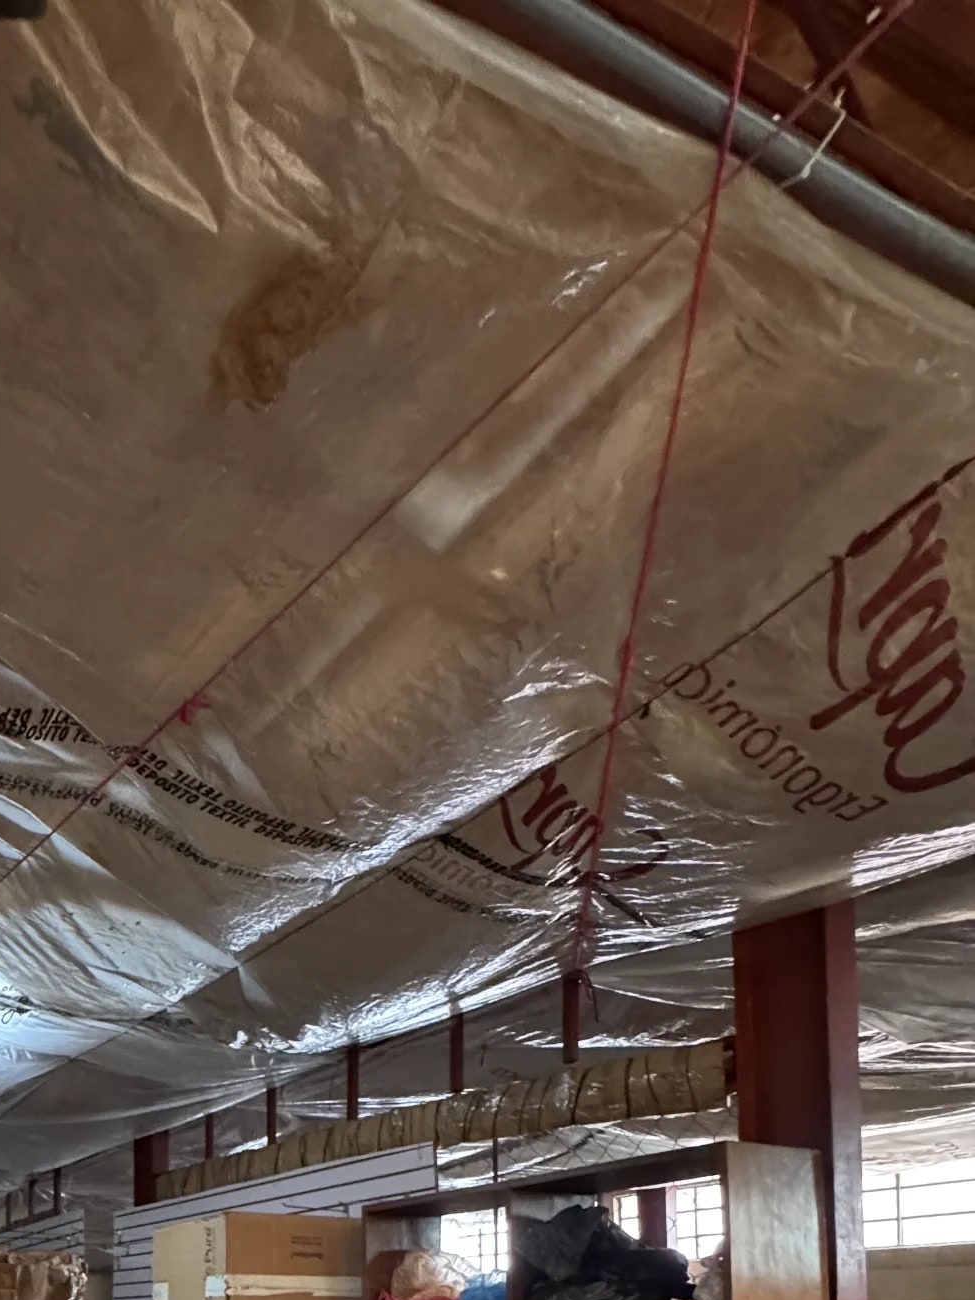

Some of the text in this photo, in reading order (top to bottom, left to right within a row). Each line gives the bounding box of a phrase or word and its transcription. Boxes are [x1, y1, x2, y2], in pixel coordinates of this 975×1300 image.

[125, 755, 200, 805] DEPOSITO
[199, 800, 252, 829] TEXTIL
[174, 768, 224, 800] TEXTIL
